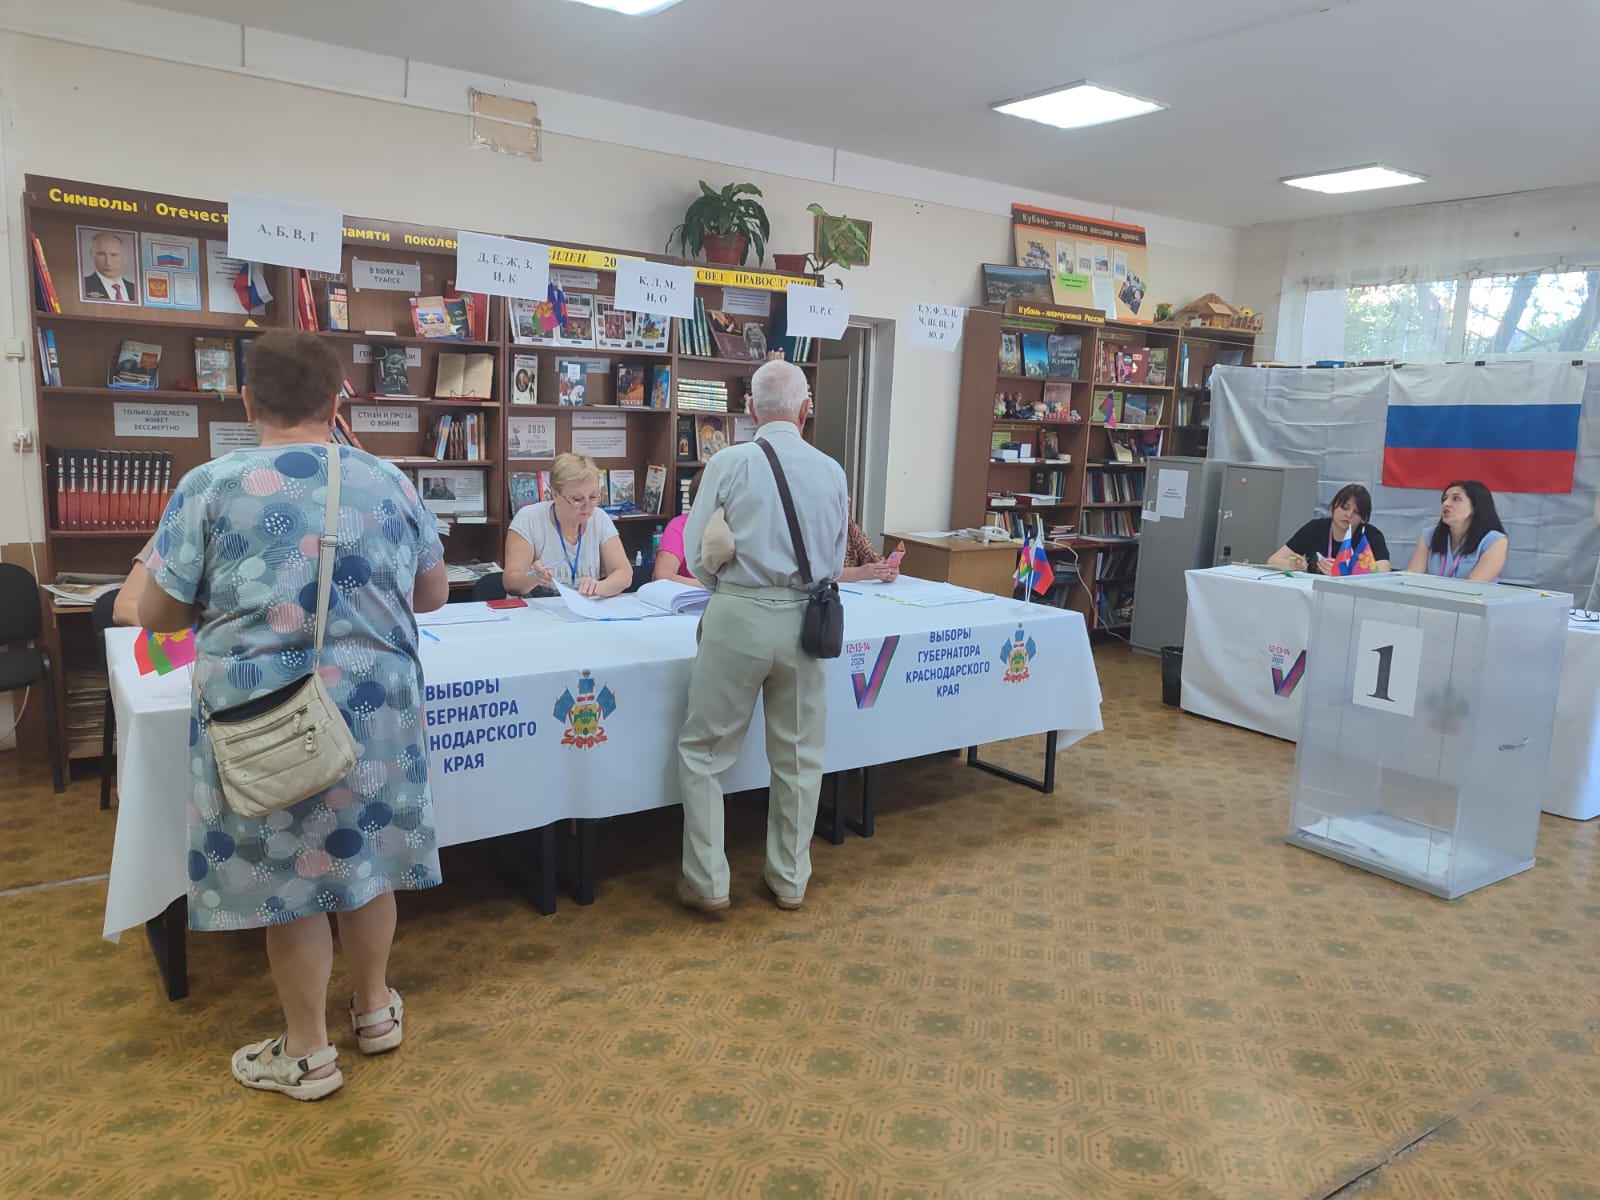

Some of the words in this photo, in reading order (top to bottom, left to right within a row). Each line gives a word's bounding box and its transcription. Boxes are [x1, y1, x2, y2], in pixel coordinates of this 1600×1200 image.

[49, 188, 138, 213] Символы
[257, 223, 272, 236] А,
[276, 225, 289, 239] Б,
[293, 228, 306, 242] В,
[310, 231, 320, 242] Г
[1068, 223, 1088, 233] слово
[477, 252, 489, 265] Д,
[492, 254, 503, 266] Е,
[507, 256, 521, 270] Ж,
[375, 267, 394, 275] БОЯХ
[508, 273, 517, 284] К
[374, 275, 401, 285] ТУАПСЕ
[639, 275, 649, 286] К,
[696, 270, 725, 283] СВЕТ
[735, 273, 811, 289] ПРАВОСЛ
[659, 294, 668, 304] О
[827, 307, 834, 316] С
[1018, 305, 1041, 317] Кубань
[1084, 314, 1105, 324] России
[122, 408, 151, 416] ТОЛЬКО
[153, 409, 190, 418] ДОБЛЕСТЬ
[358, 411, 382, 419] СТИХИ
[390, 412, 412, 420] ПРОЗА
[377, 418, 401, 427] ВОЙНЕ
[929, 627, 971, 643] ВЫБОРЫ
[850, 657, 865, 667] 2025
[917, 645, 981, 663] ГУБЕРНАТОРА
[905, 661, 990, 684] КРАСНОДАРСКОГО
[1366, 644, 1396, 702] 1
[425, 677, 500, 701] ВЫБОРЫ
[936, 683, 960, 698] КРАЯ
[426, 699, 519, 726] БЕРНАТОРА
[429, 721, 537, 751] НОДАРСКОГО
[443, 752, 485, 774] КРАЯ
